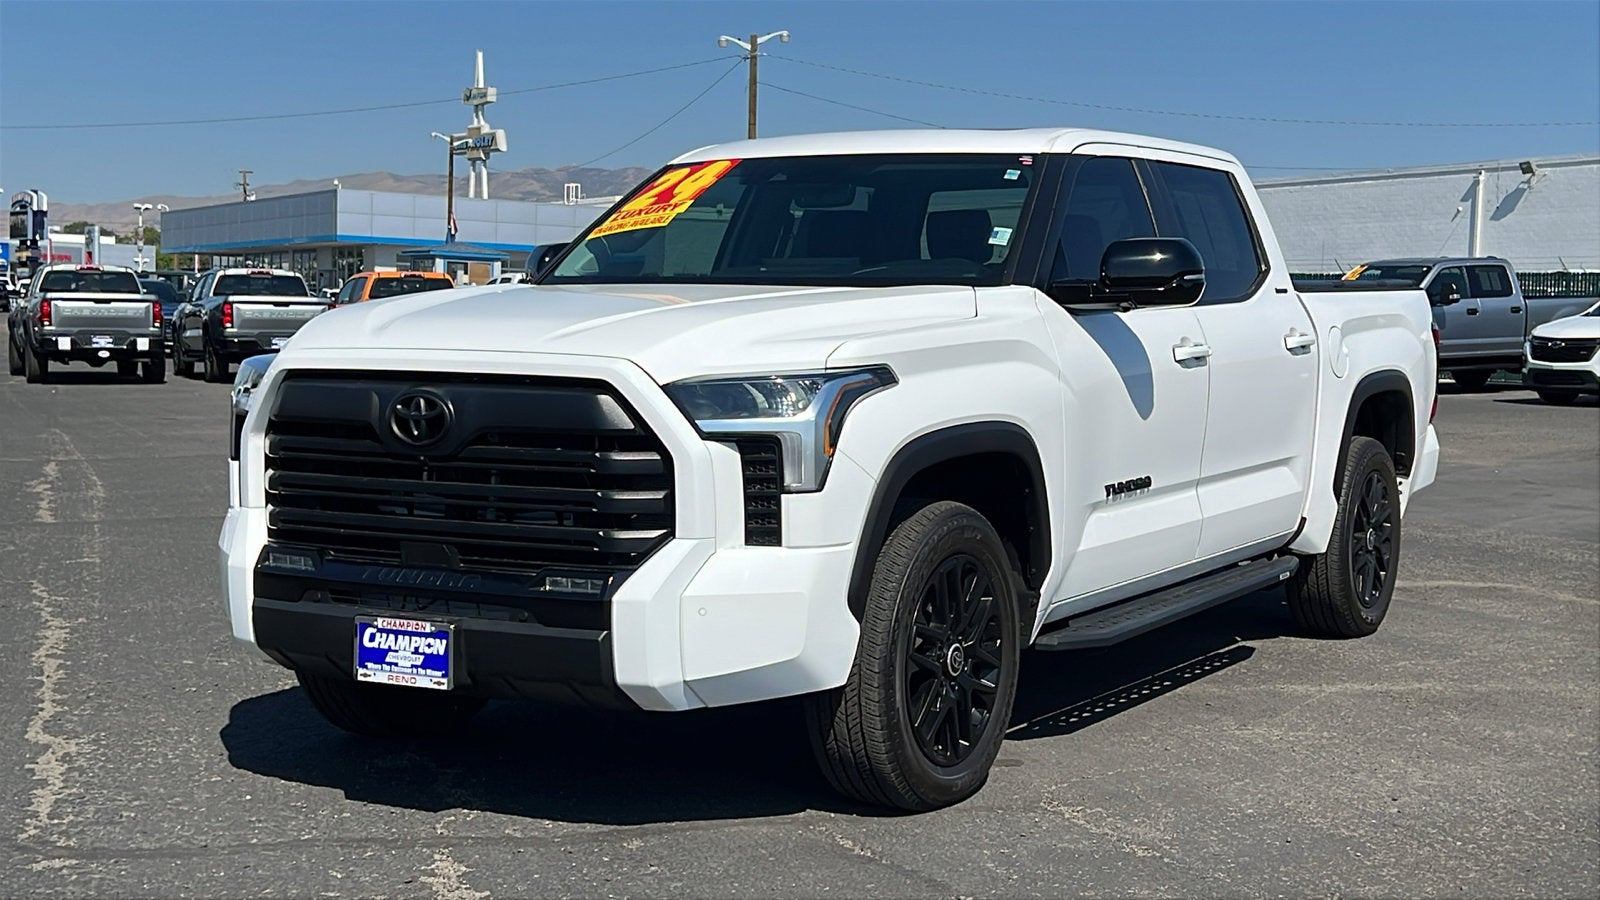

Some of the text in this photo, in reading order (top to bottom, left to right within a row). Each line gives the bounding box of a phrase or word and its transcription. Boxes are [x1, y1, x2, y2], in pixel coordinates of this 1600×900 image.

[620, 160, 733, 211] 24
[610, 201, 688, 223] LUXURY
[1104, 475, 1153, 498] TUNDRA
[381, 619, 427, 631] CHAMPION
[362, 627, 447, 655] CHAMPION
[388, 654, 421, 663] CHEVROLET
[387, 674, 417, 685] RENO
